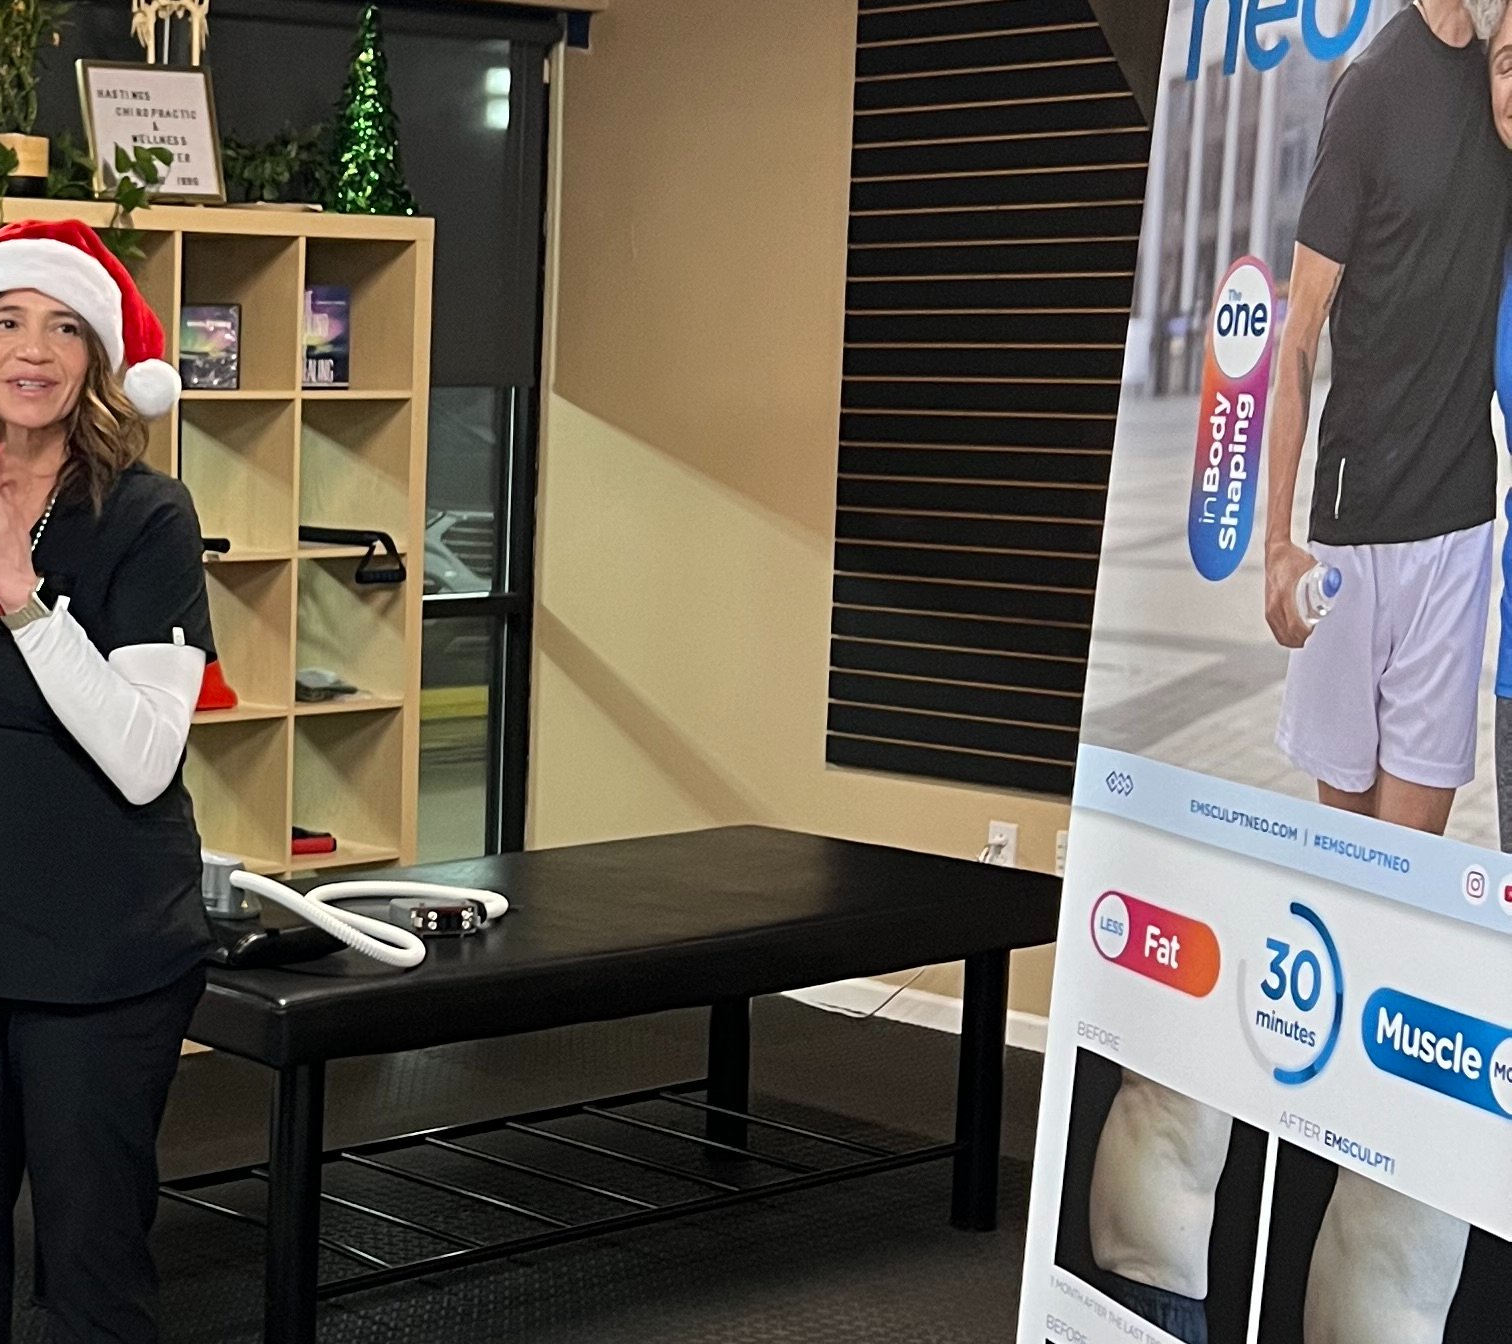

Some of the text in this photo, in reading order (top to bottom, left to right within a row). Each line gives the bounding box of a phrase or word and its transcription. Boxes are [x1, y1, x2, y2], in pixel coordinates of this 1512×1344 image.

[1217, 302, 1267, 337] one
[1198, 391, 1231, 524] in Body
[1190, 799, 1410, 873] EMSCULPTNEO.COM #EMSCULPTNEO
[1100, 915, 1180, 970] LESS Fat
[1260, 937, 1322, 1012] 30
[1078, 1020, 1120, 1052] BEFORE
[1256, 1009, 1316, 1048] minutes
[1376, 1007, 1483, 1080] Muscle
[1279, 1111, 1321, 1142] AFTER
